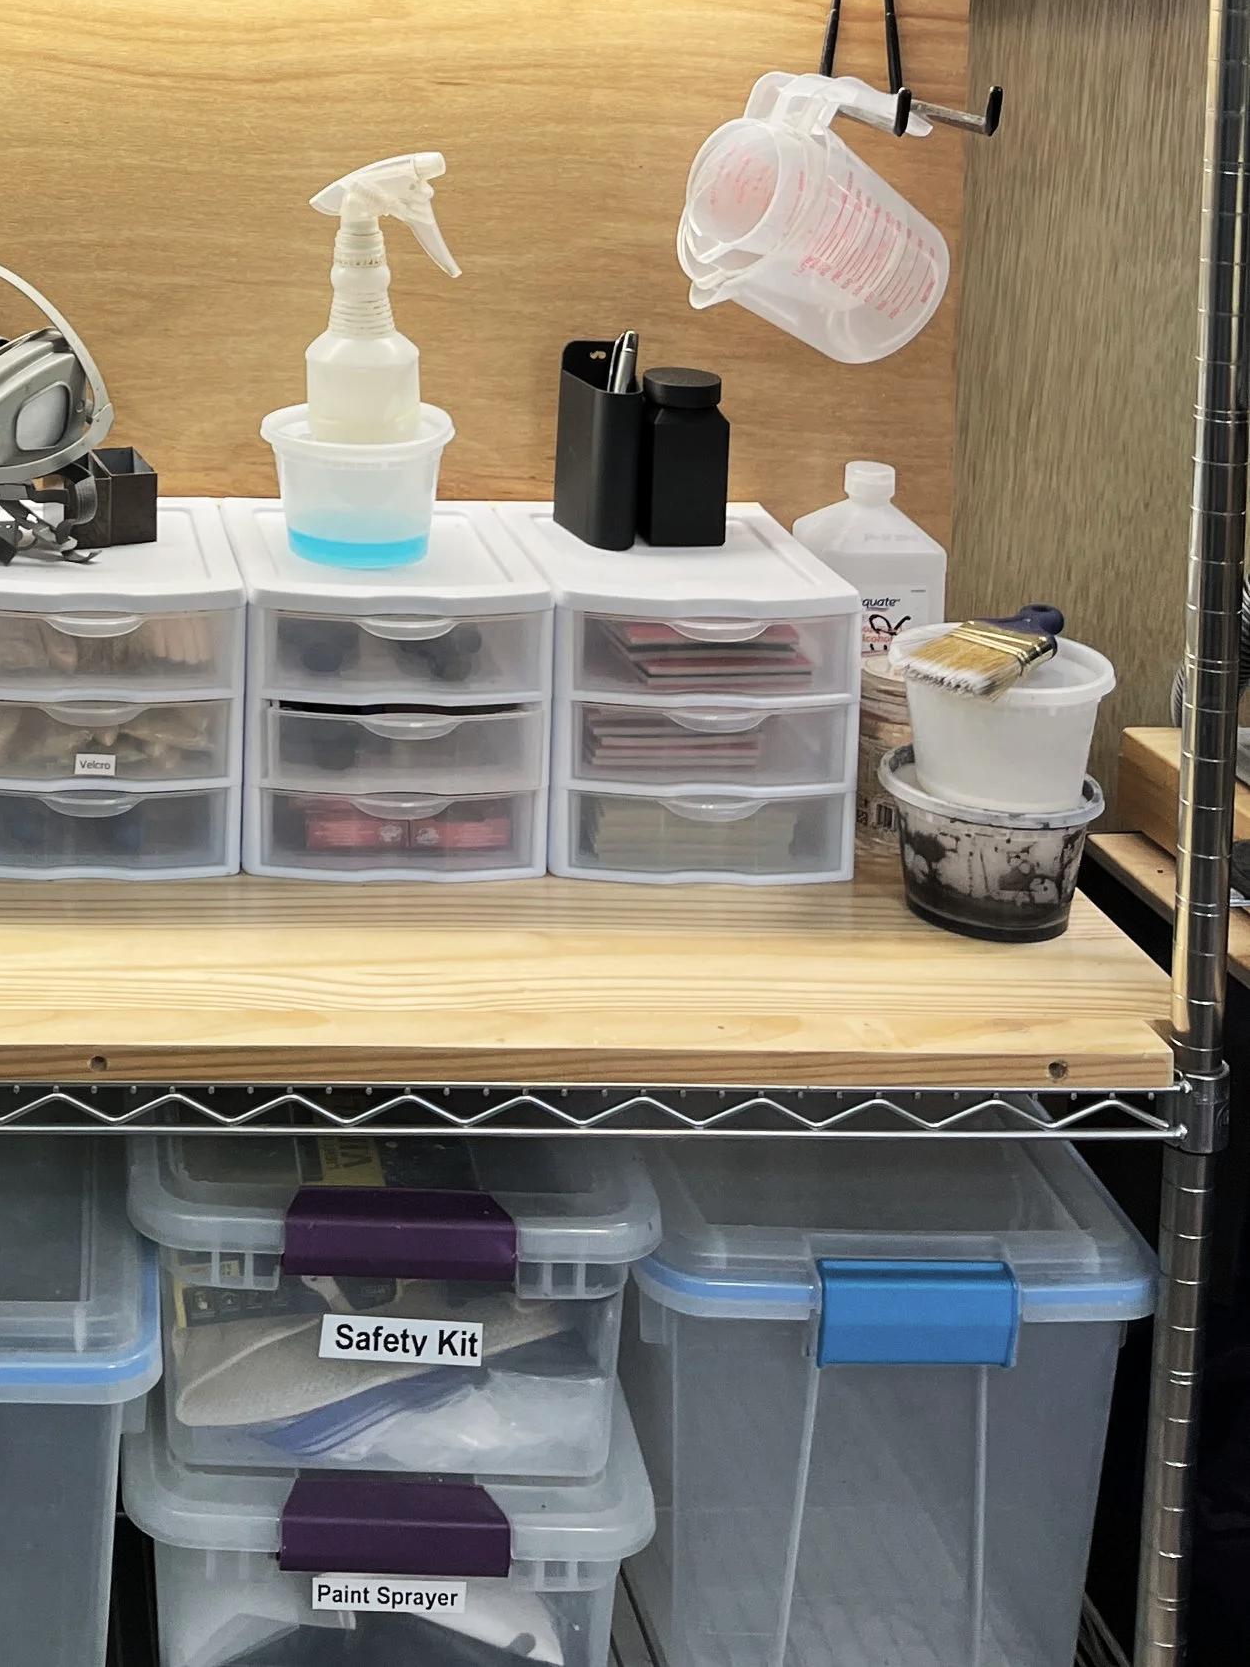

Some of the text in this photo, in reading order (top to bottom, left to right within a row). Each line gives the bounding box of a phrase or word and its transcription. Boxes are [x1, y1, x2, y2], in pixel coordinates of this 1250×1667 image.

[80, 760, 111, 770] Velcro
[335, 1323, 479, 1357] Safety Kit
[317, 1584, 458, 1610] Paint Sprayer
